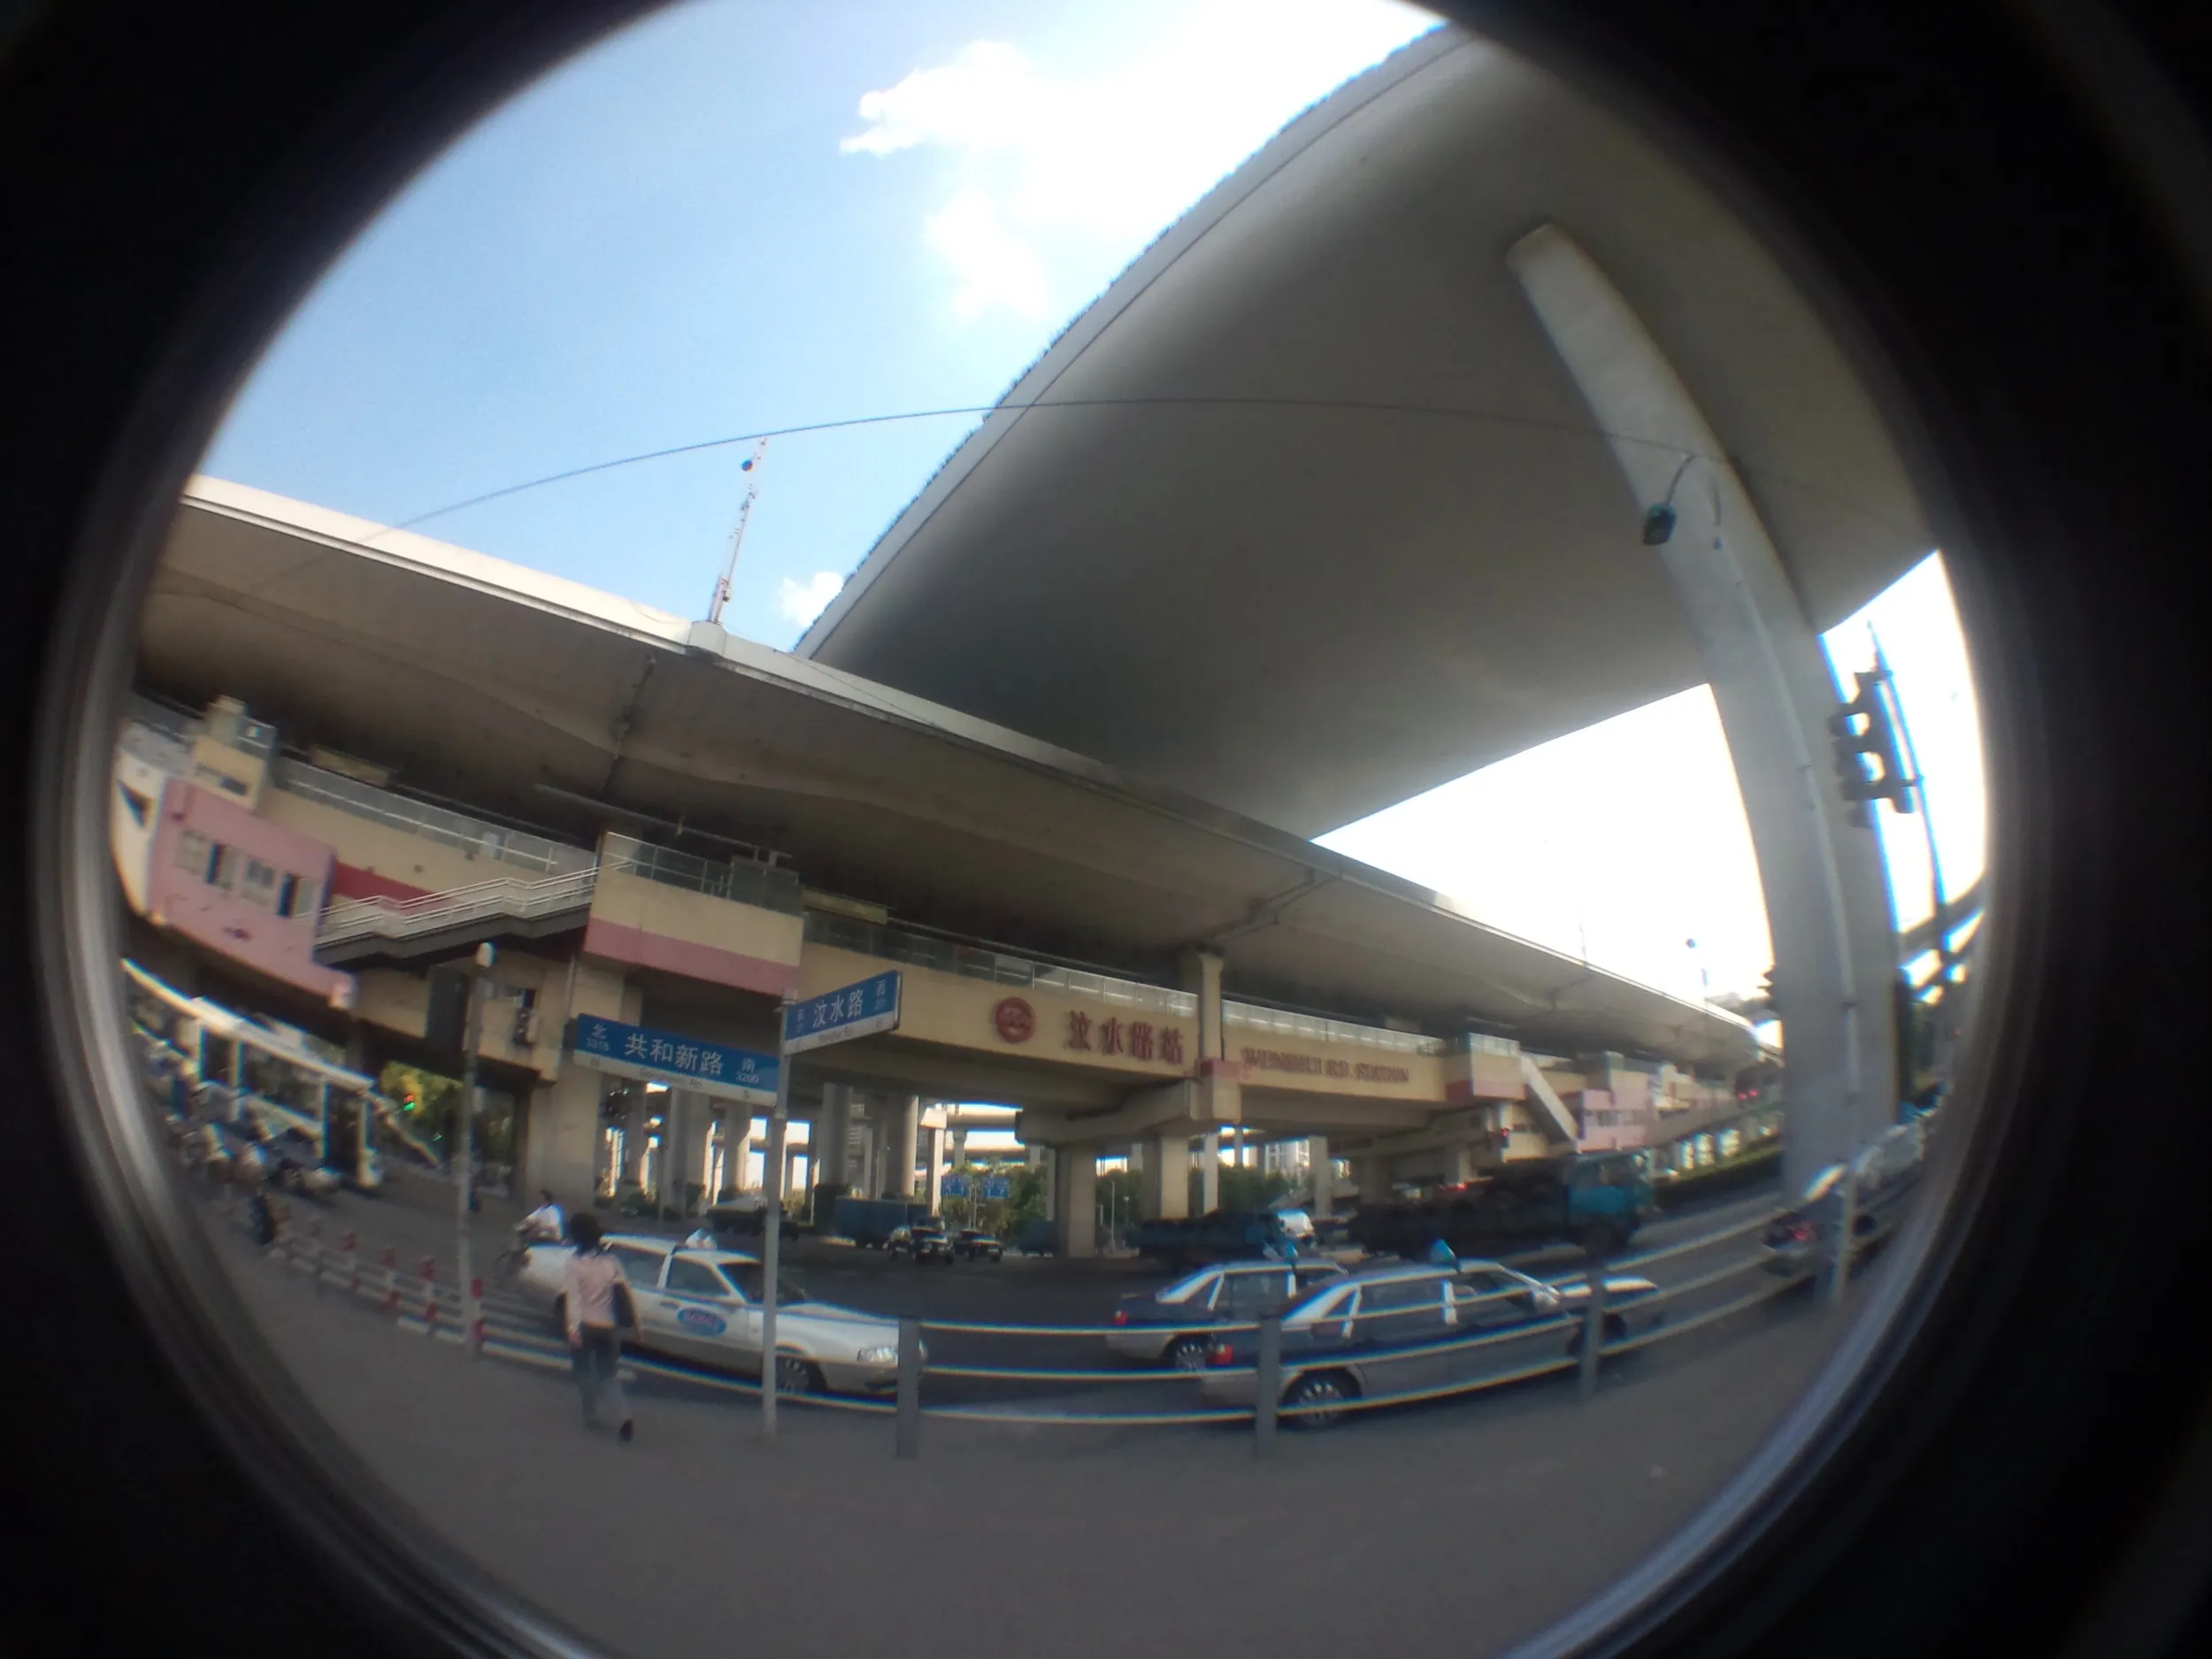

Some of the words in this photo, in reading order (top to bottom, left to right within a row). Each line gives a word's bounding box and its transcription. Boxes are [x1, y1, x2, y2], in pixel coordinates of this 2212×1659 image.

[812, 988, 864, 1029] 汶水路
[624, 1033, 724, 1076] 共和新路
